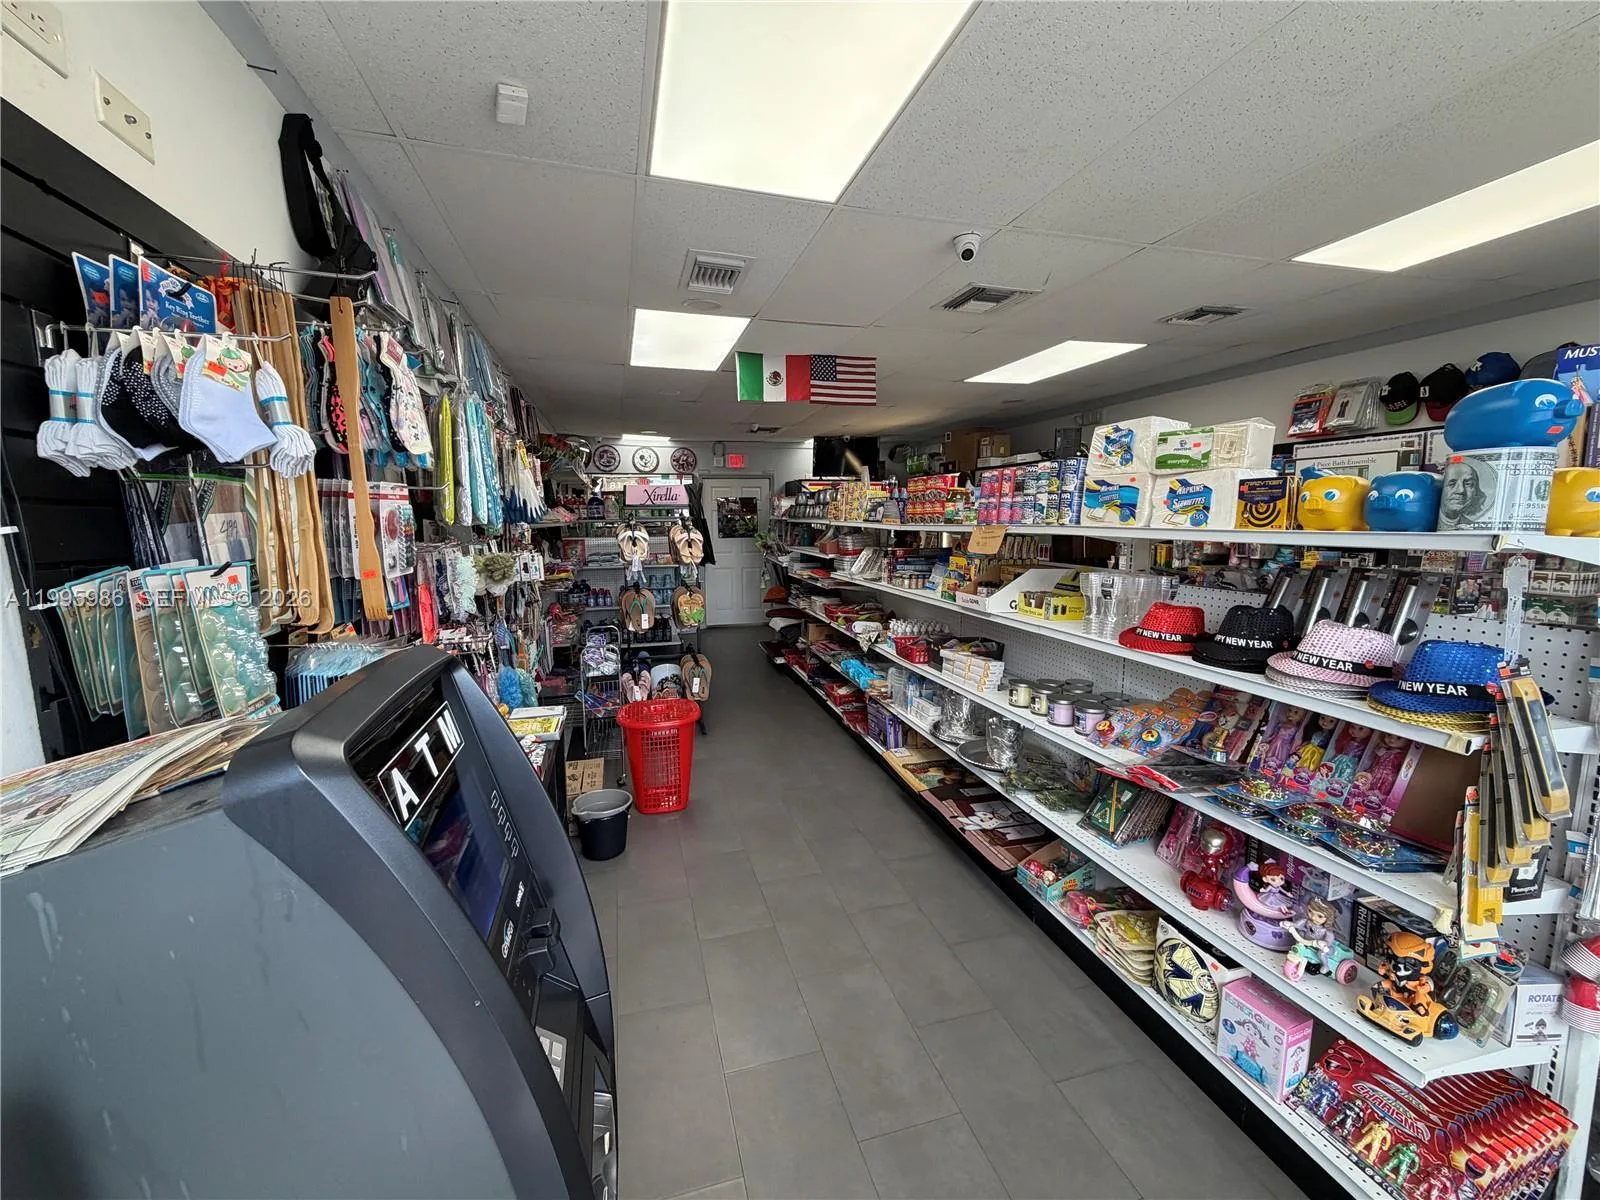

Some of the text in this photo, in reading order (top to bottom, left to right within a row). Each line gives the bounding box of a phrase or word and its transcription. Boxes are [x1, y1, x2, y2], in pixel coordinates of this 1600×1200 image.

[1564, 345, 1600, 359] MUS
[1347, 457, 1377, 465] Ensemble
[641, 487, 678, 505] Xirella
[1176, 485, 1204, 496] NAPKINS
[1143, 630, 1160, 639] NEW
[1160, 633, 1182, 642] YEAR
[1225, 636, 1247, 647] NEW
[1248, 639, 1274, 649] YEAR
[1297, 653, 1353, 672] NEW YEAR
[1400, 681, 1468, 697] NEW YEAR
[391, 709, 462, 822] ATM
[1355, 906, 1368, 955] RHUBARB
